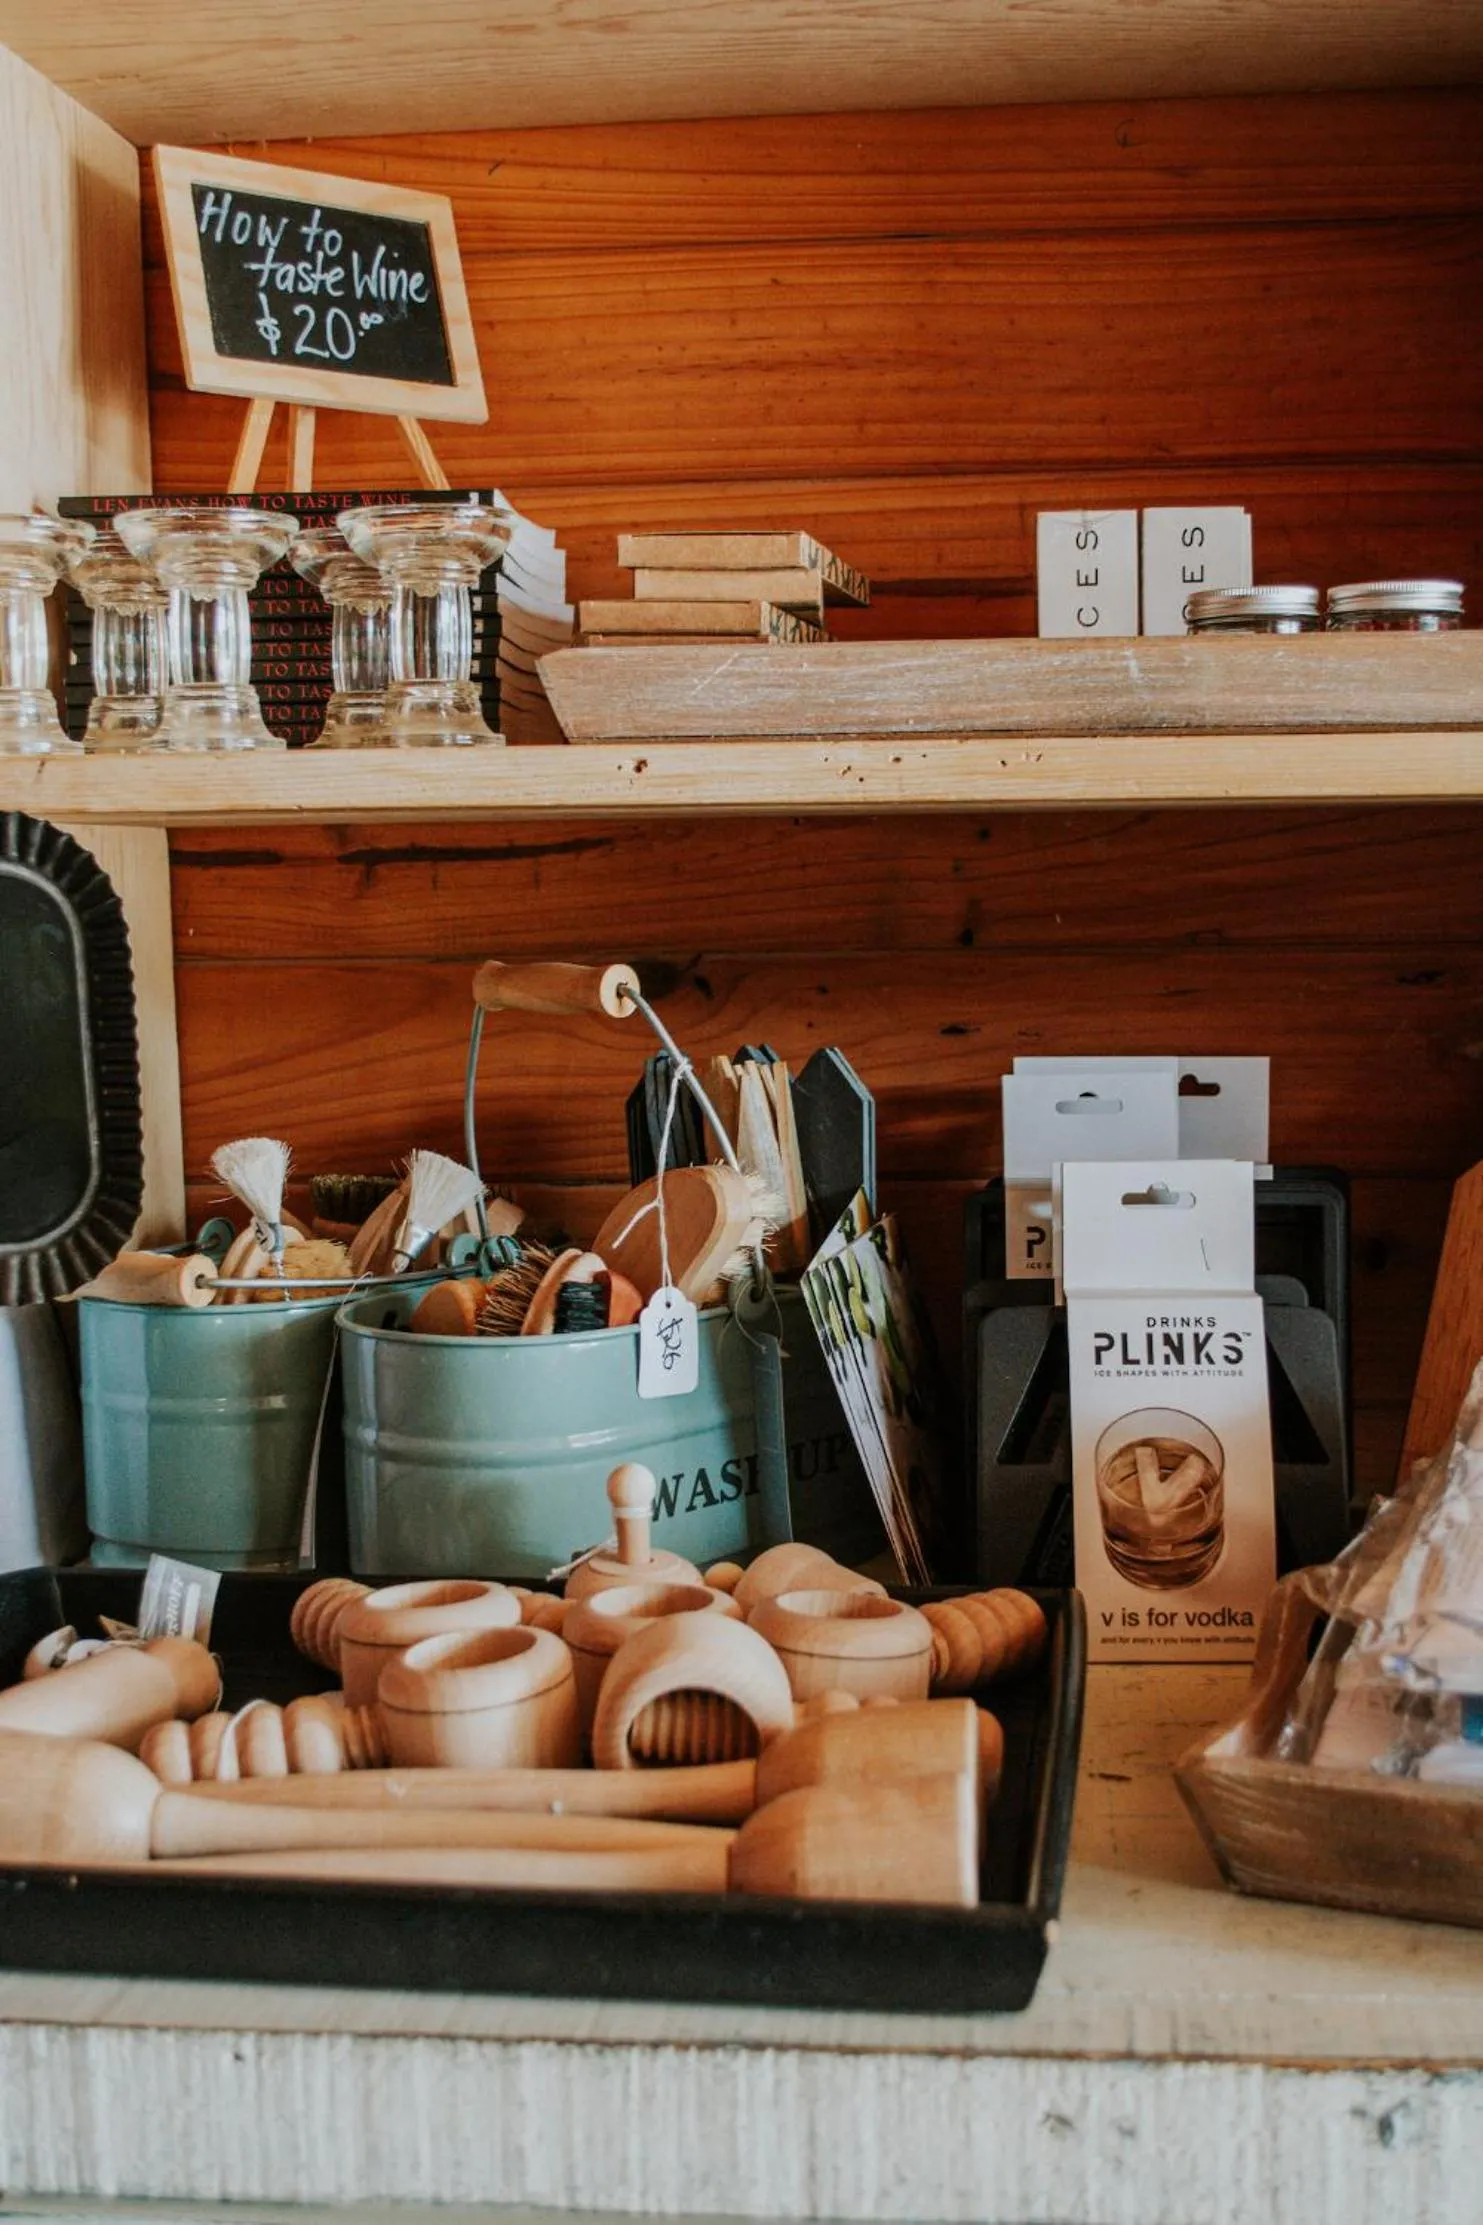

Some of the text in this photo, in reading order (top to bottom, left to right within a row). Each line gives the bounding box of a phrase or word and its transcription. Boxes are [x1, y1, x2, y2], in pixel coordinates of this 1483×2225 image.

[200, 191, 343, 257] How to
[243, 245, 429, 303] taste Wine
[92, 498, 129, 513] LEN
[208, 496, 252, 509] HOW
[260, 495, 286, 510] TO
[293, 494, 353, 508] TASTE
[360, 493, 412, 506] WINE
[305, 515, 337, 528] TAS
[1181, 526, 1204, 625] ES
[263, 600, 291, 615] TO
[297, 599, 333, 614] TAS
[267, 621, 294, 636] TO
[301, 621, 333, 635] TAS
[265, 642, 292, 657] TO
[297, 642, 333, 656] TAS
[262, 661, 331, 677] TO TAS
[264, 684, 333, 699] TO TAS
[265, 705, 292, 720] TO
[1146, 1316, 1217, 1328] DRINKS
[1094, 1369, 1245, 1377] ICE SHAPES WITH ATTITUDE
[1101, 1607, 1254, 1627] v is for vodka
